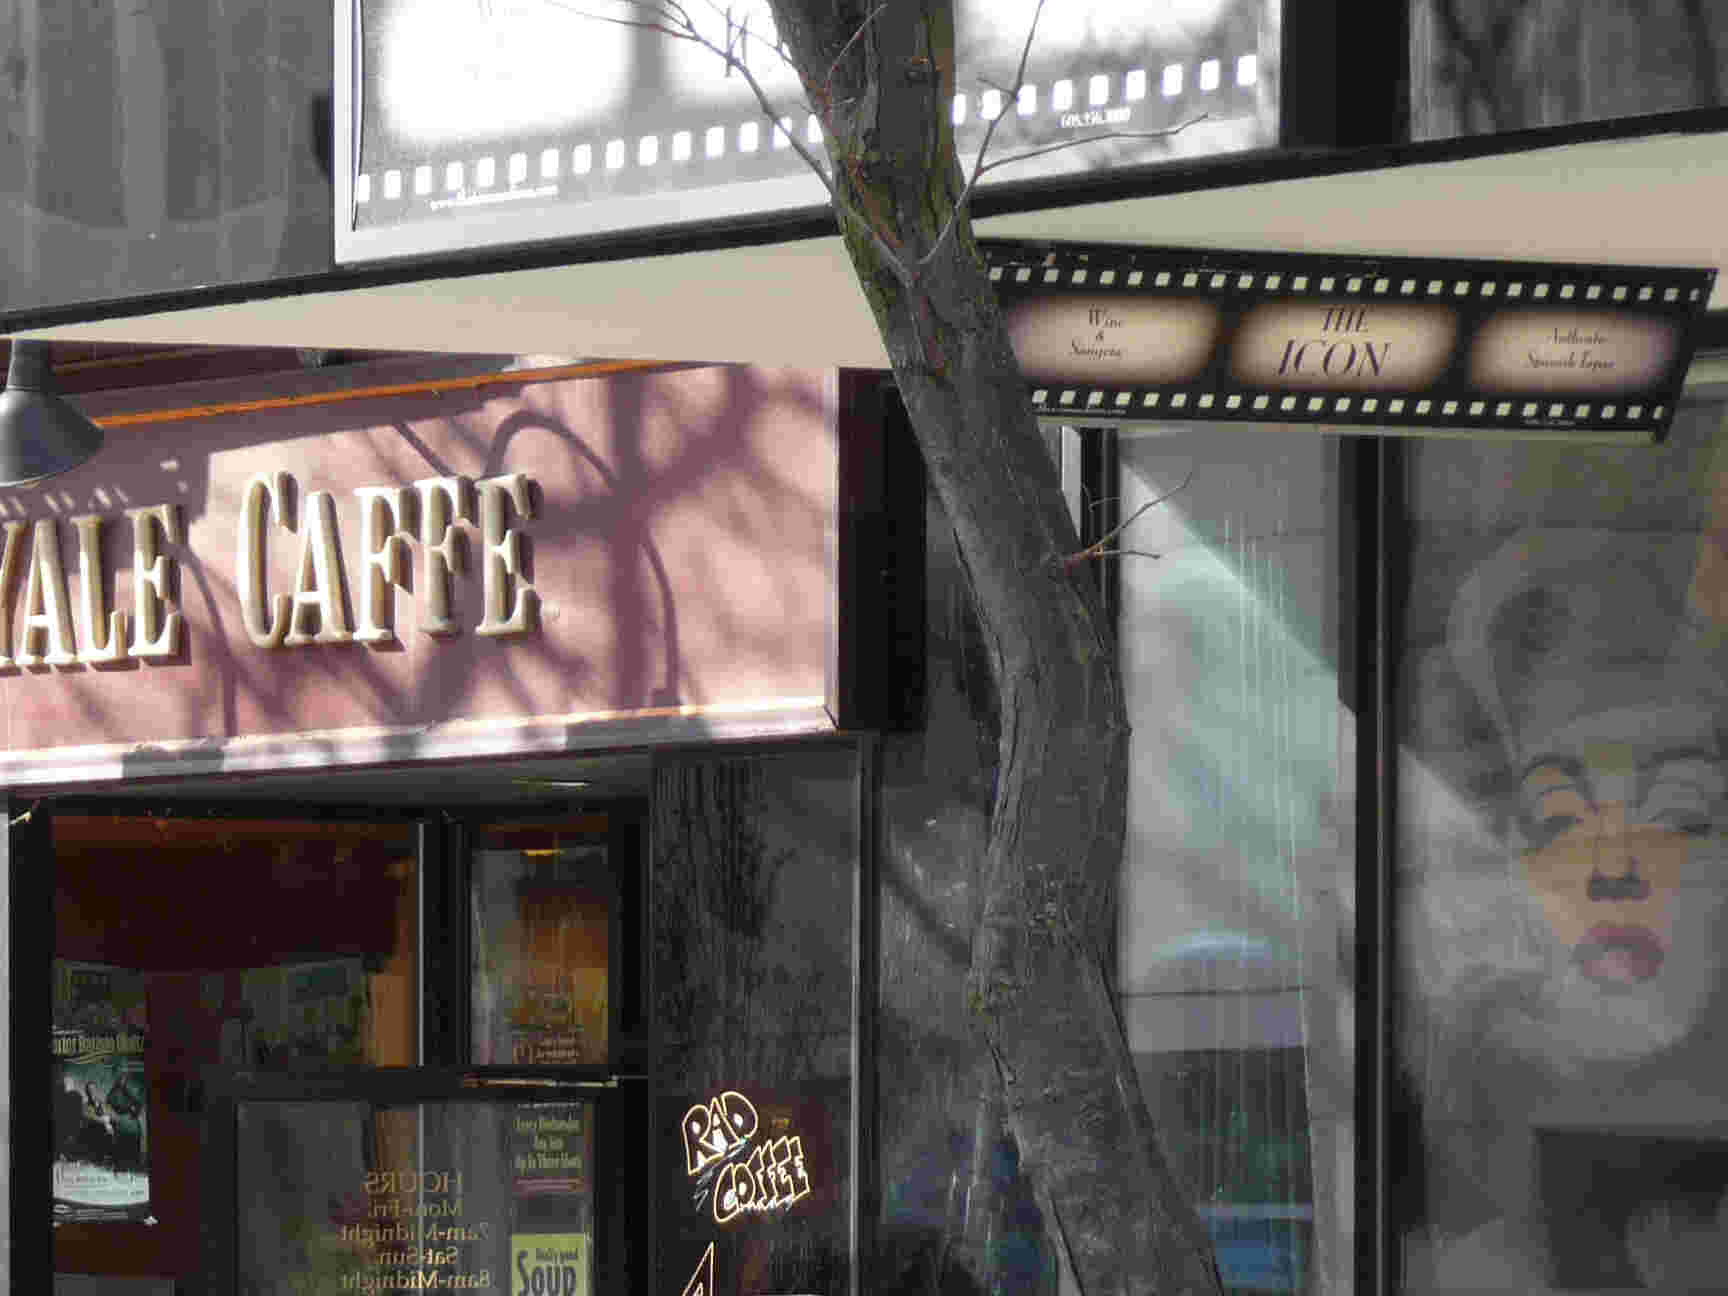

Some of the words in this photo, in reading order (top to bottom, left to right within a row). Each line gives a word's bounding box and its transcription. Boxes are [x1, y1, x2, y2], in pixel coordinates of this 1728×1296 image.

[1274, 338, 1391, 377] ICON
[1321, 306, 1369, 333] THE
[235, 470, 542, 654] CAFFE
[682, 1090, 759, 1177] RAD
[713, 1135, 811, 1223] COFFEE
